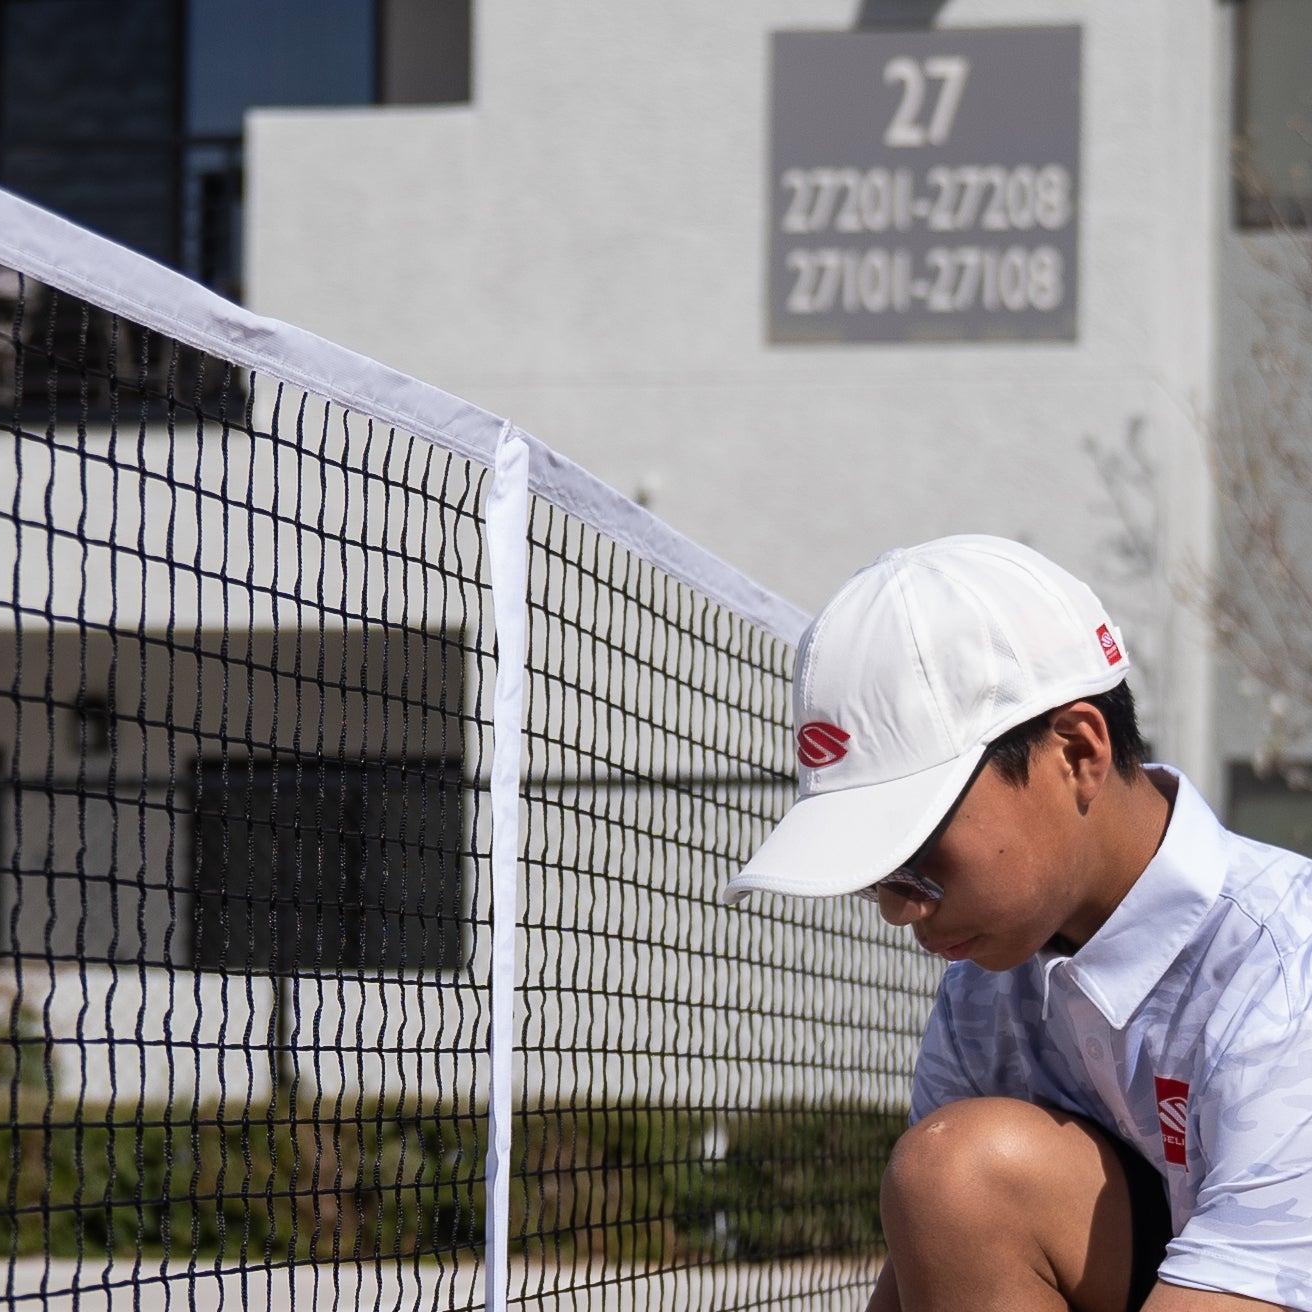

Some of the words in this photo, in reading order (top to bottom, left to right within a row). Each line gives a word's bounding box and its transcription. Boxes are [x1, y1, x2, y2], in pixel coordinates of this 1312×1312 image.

[883, 55, 969, 148] 27
[781, 163, 1073, 234] 27201-27208
[785, 246, 1065, 314] 27101-27108
